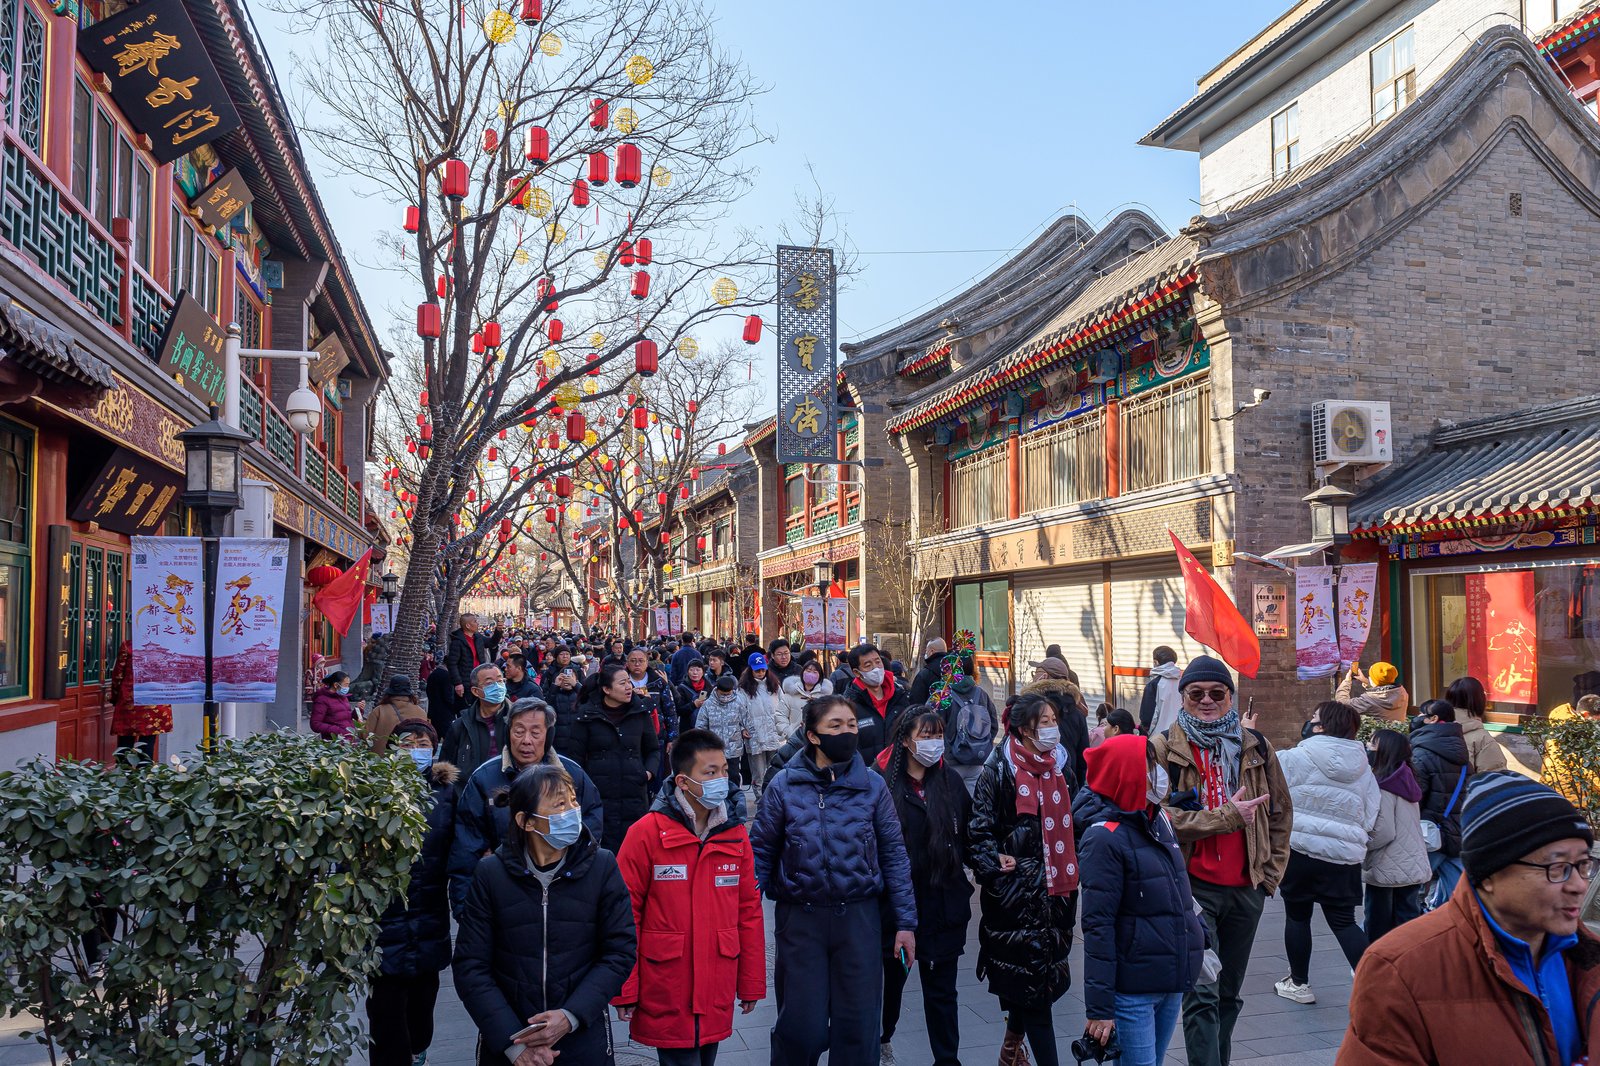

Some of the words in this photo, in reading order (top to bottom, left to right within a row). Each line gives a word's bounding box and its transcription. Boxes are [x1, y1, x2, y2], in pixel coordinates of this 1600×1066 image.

[146, 584, 194, 596] 城之源
[147, 604, 194, 616] 都之始
[146, 624, 196, 636] 河之端
